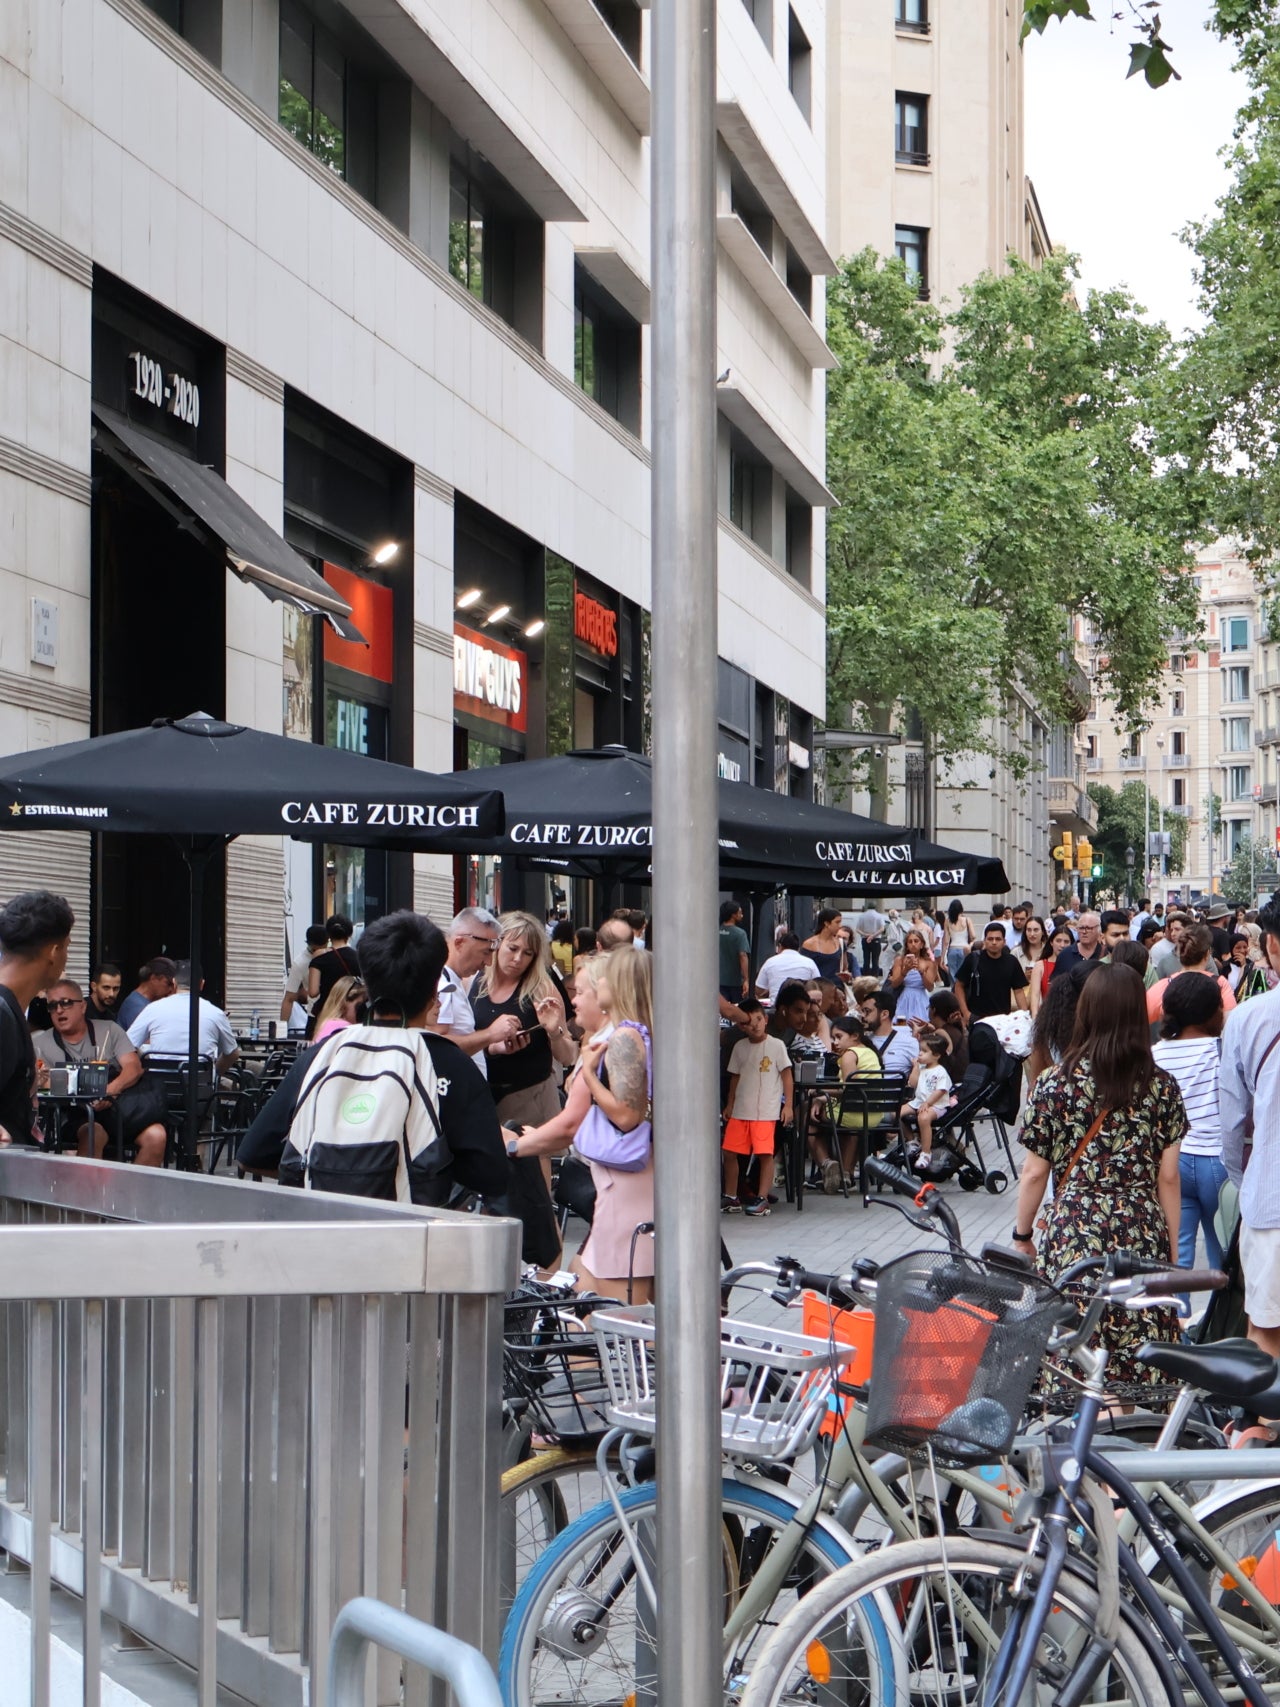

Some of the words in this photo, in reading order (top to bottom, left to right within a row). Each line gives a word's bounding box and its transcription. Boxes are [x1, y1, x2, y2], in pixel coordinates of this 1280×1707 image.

[134, 351, 163, 408] 1920
[173, 372, 200, 428] 2020
[453, 634, 483, 699] FIVE
[484, 649, 521, 714] GUYS
[336, 699, 369, 755] FIVE
[24, 804, 74, 816] ESTRELLA
[75, 807, 109, 818] DAMM
[280, 802, 360, 824] CAFE
[366, 803, 480, 828] ZURICH
[510, 823, 571, 844] CAFE
[815, 841, 855, 861] CAFE
[857, 843, 912, 863] ZURICH
[831, 869, 882, 885] CAFE
[887, 868, 966, 886] ZURICH
